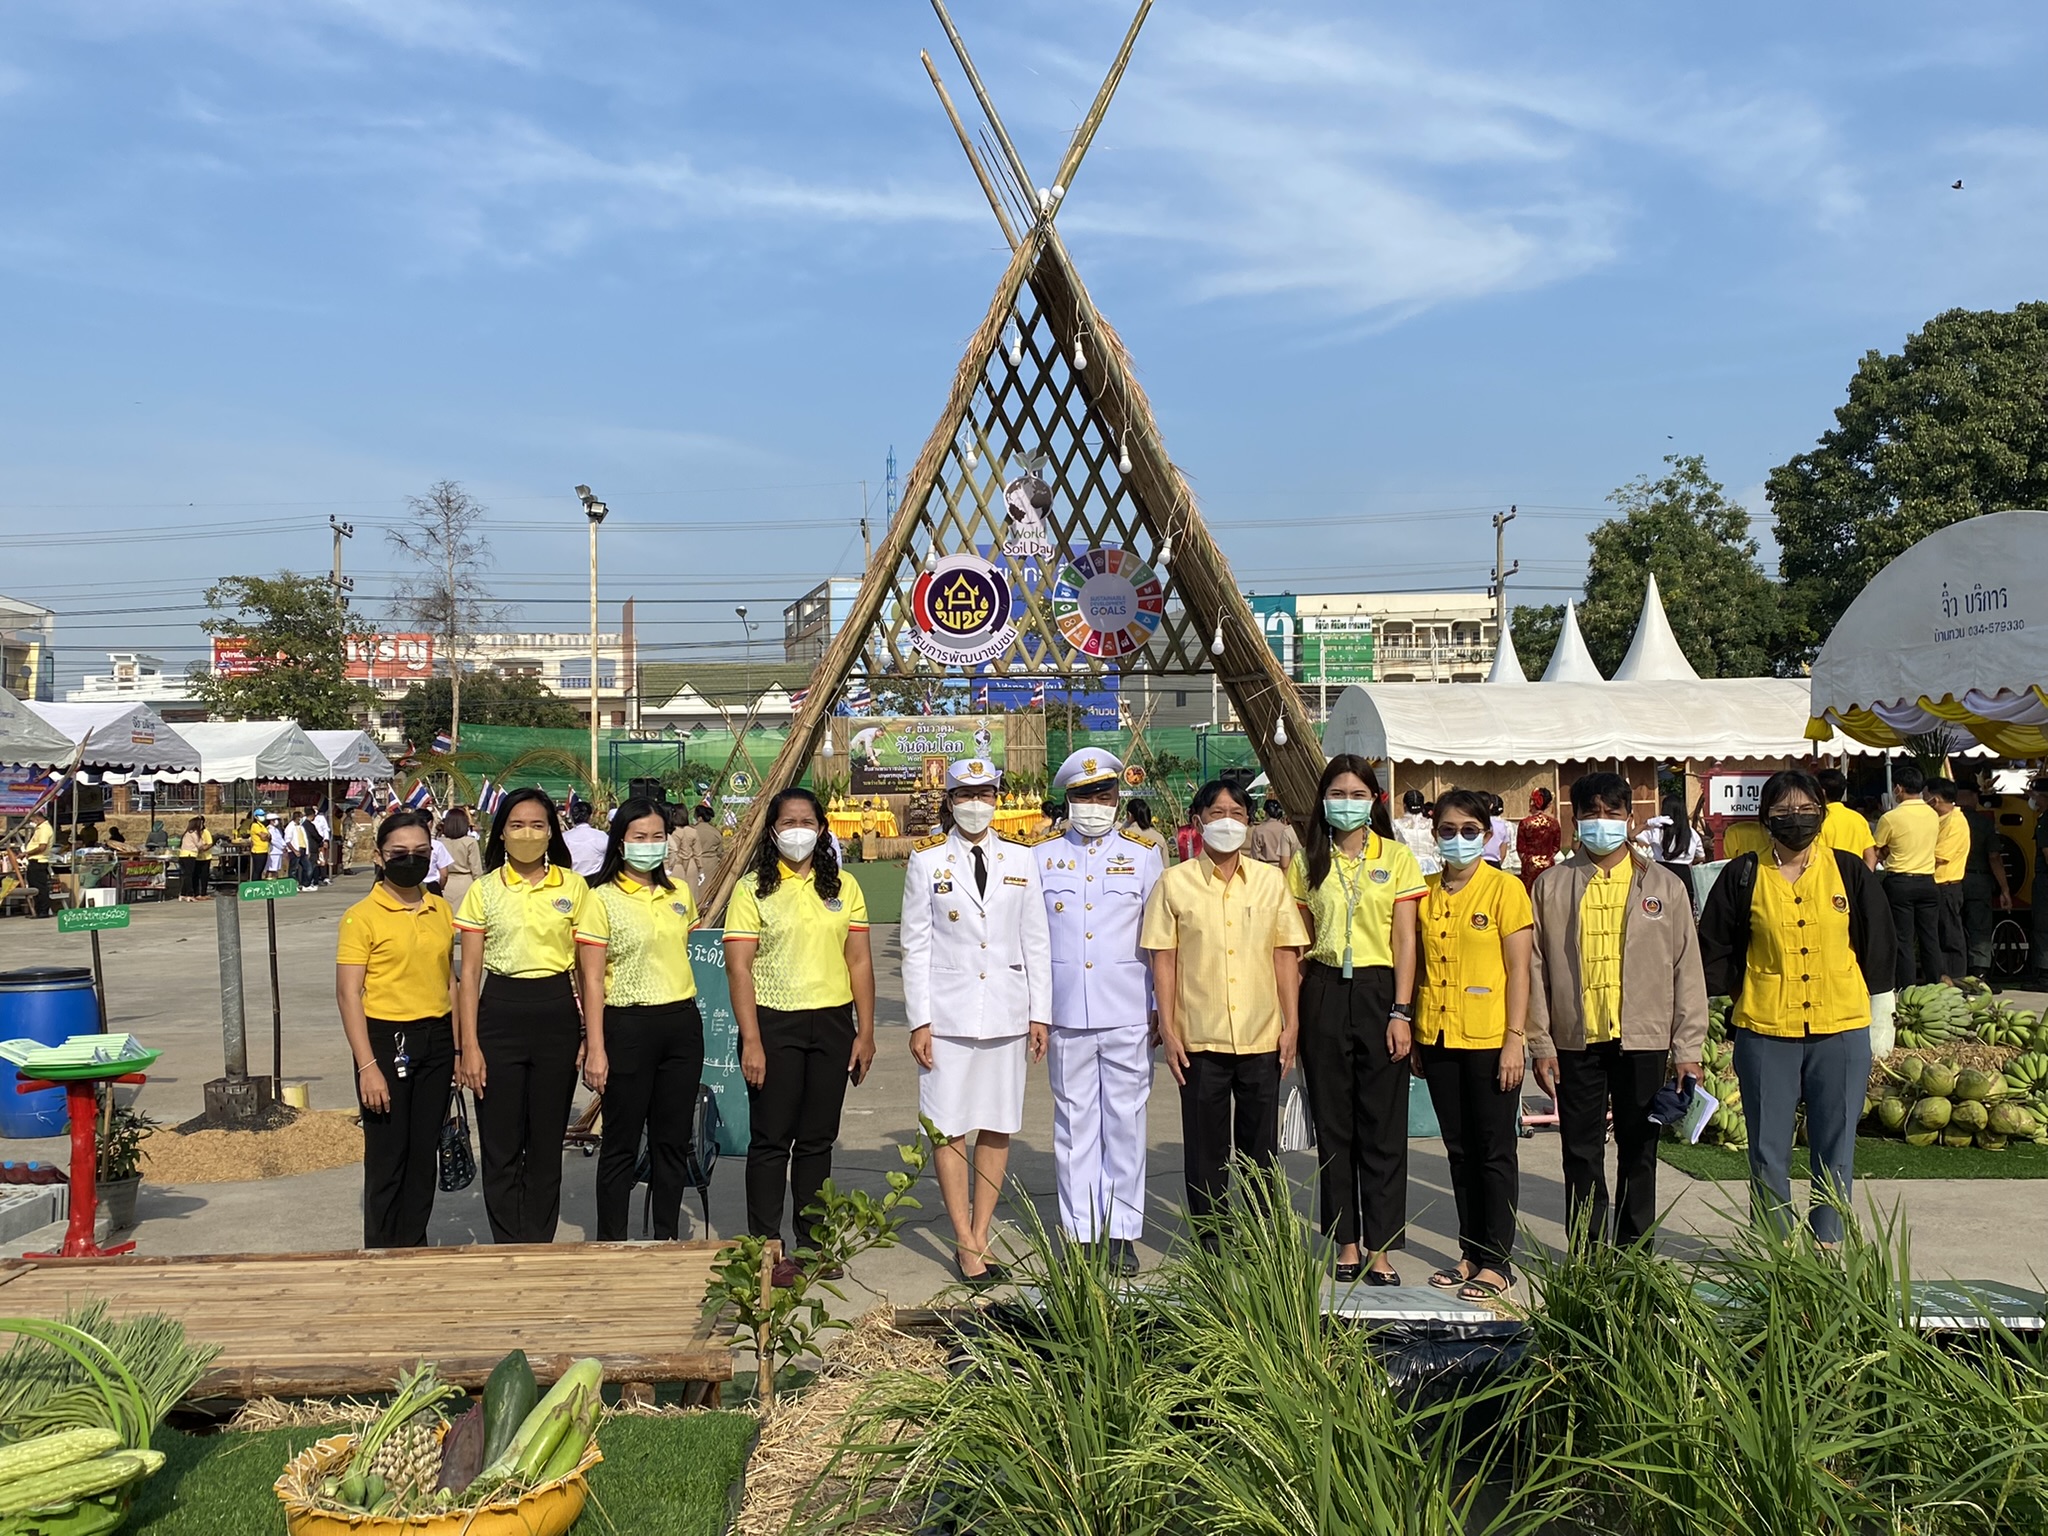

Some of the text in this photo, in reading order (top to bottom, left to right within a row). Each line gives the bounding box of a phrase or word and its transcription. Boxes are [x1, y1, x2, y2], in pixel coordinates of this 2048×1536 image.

[1010, 527, 1047, 540] World
[1004, 541, 1055, 558] Soil Day
[1965, 583, 2008, 614] บริการ
[1090, 605, 1127, 616] GOALS
[907, 628, 1017, 663] กรมการพัฒนาชุมชน
[916, 722, 955, 734] ธันวาคม
[895, 733, 965, 754] วันดินโลก
